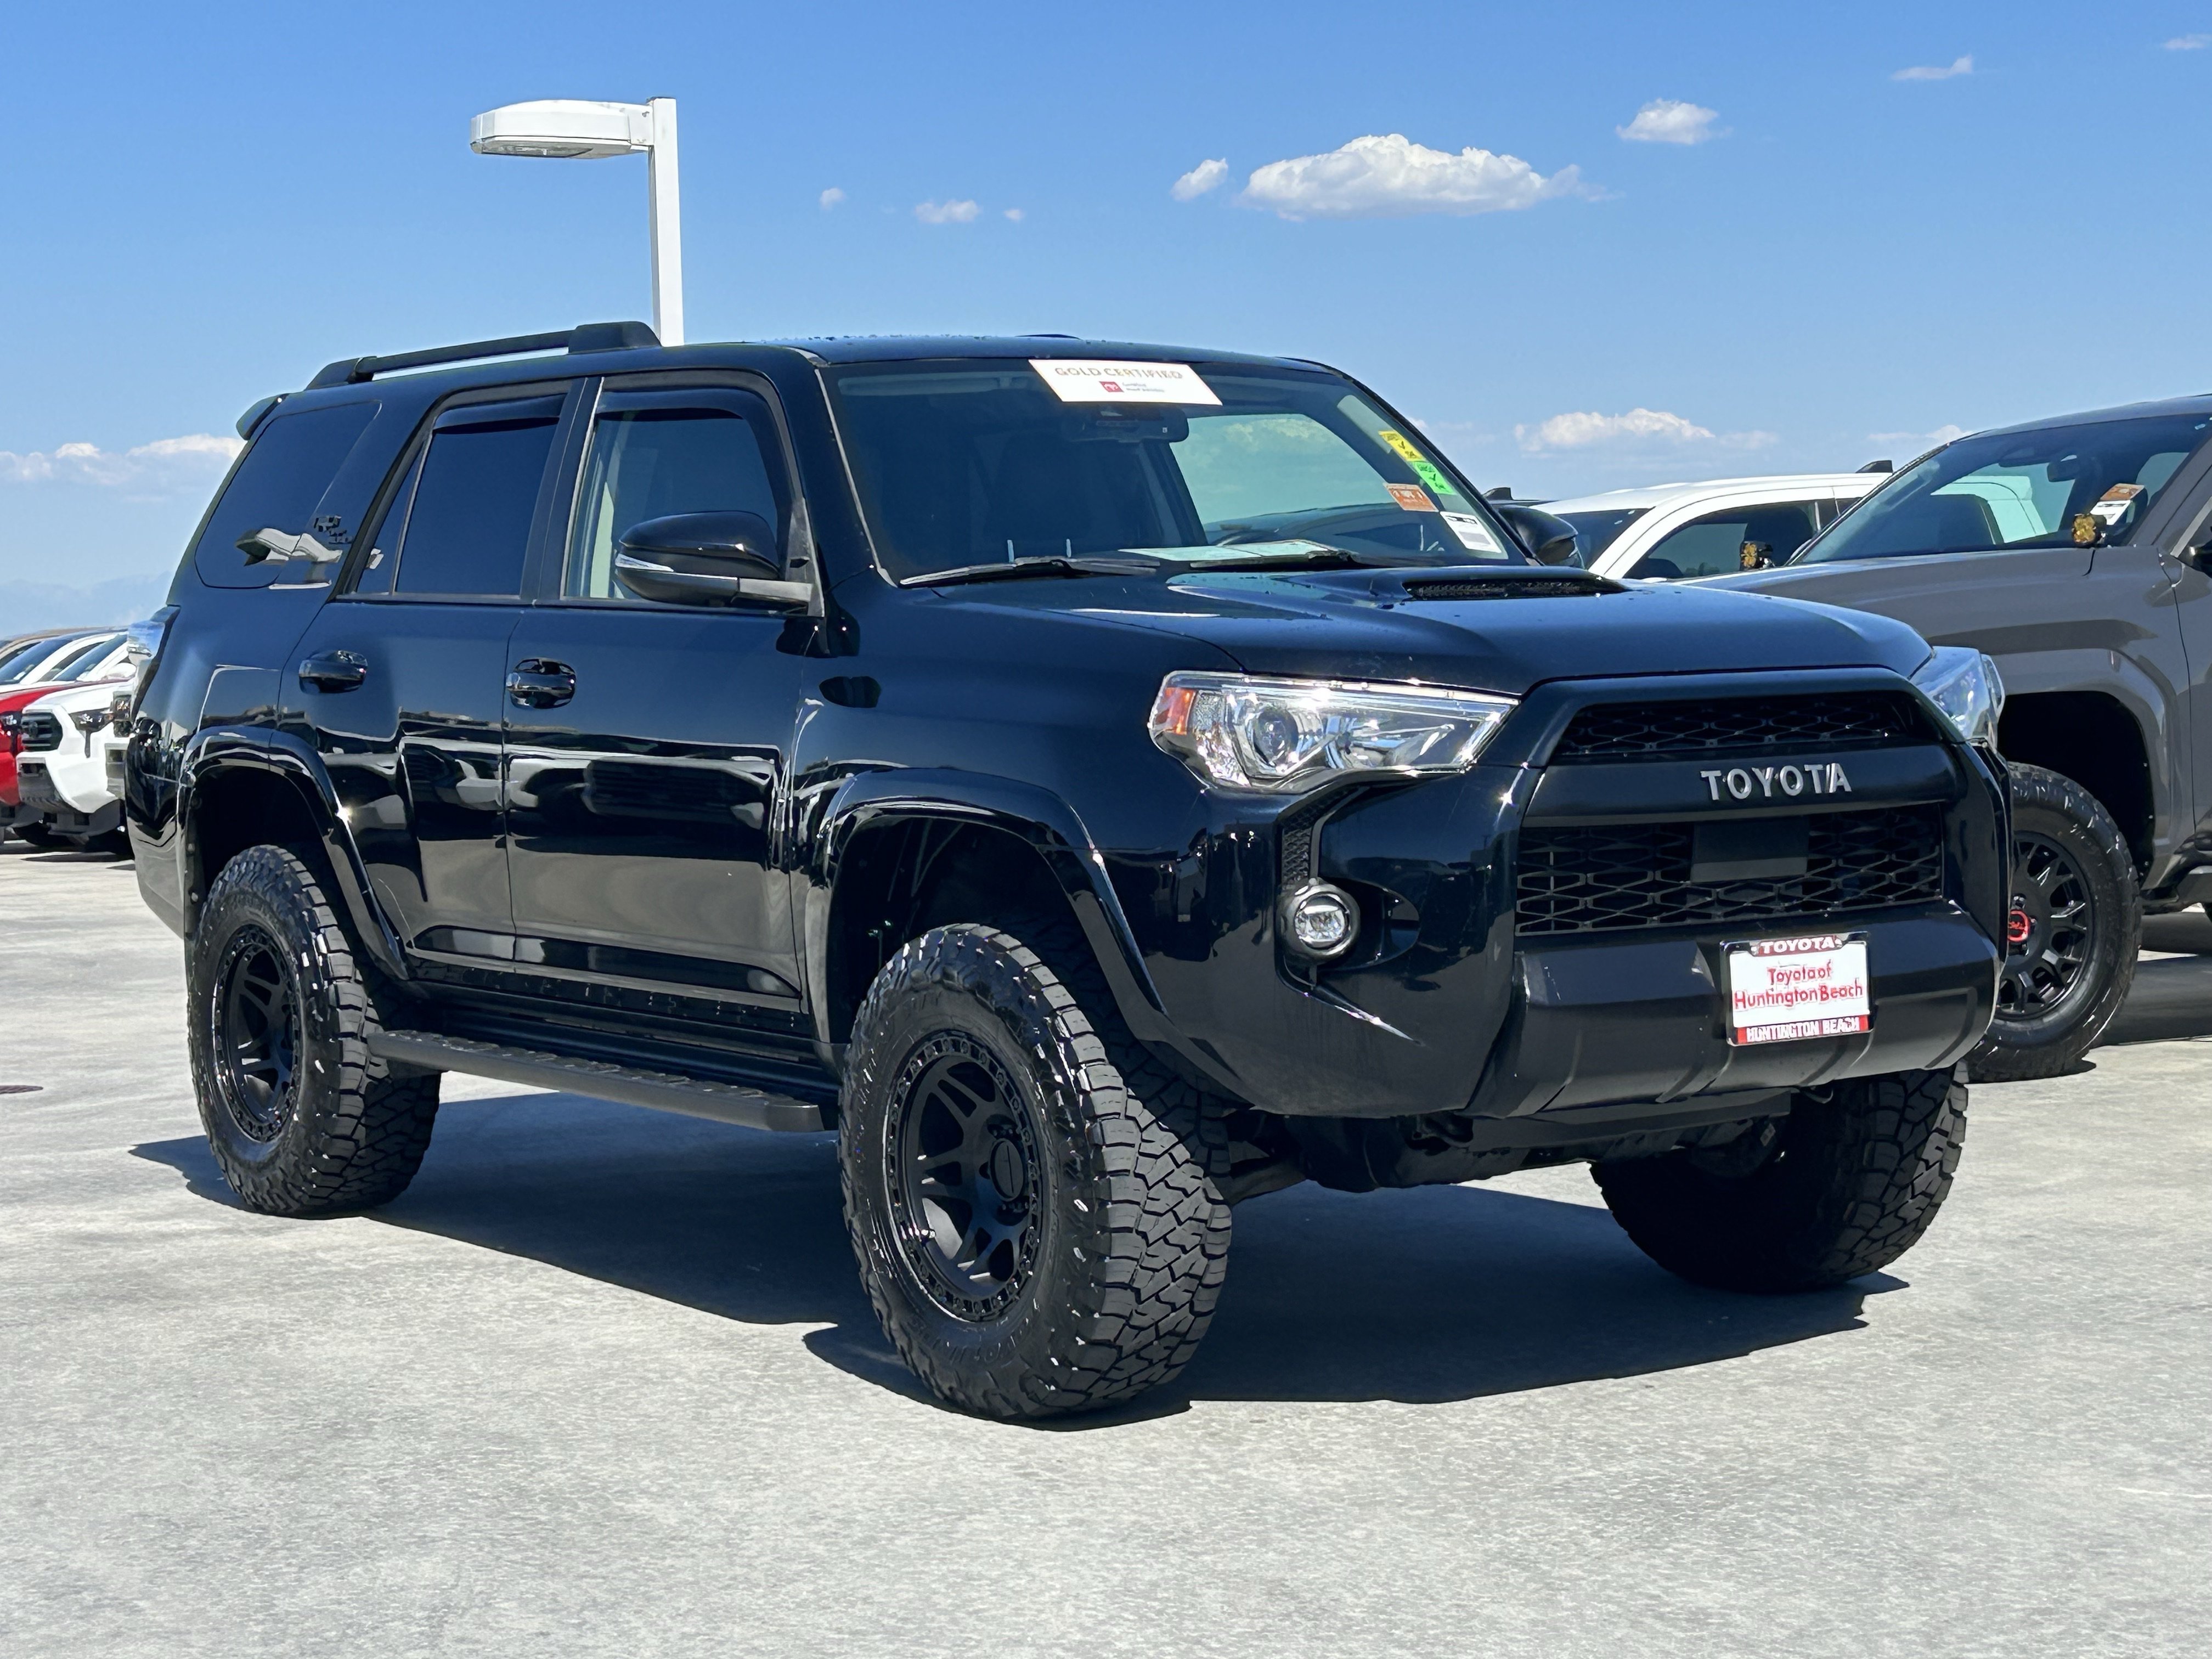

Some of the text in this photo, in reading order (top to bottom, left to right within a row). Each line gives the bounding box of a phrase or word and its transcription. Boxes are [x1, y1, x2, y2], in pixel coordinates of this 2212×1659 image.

[1054, 367, 1183, 379] GOLD CERTIFIED
[1700, 763, 1852, 800] TOYOTA
[1760, 936, 1835, 954] TOYOTA
[1768, 960, 1832, 985] Toyota of
[1734, 978, 1863, 1009] Huntington Beach
[1746, 1016, 1860, 1042] HUNTINGTON BEACH
